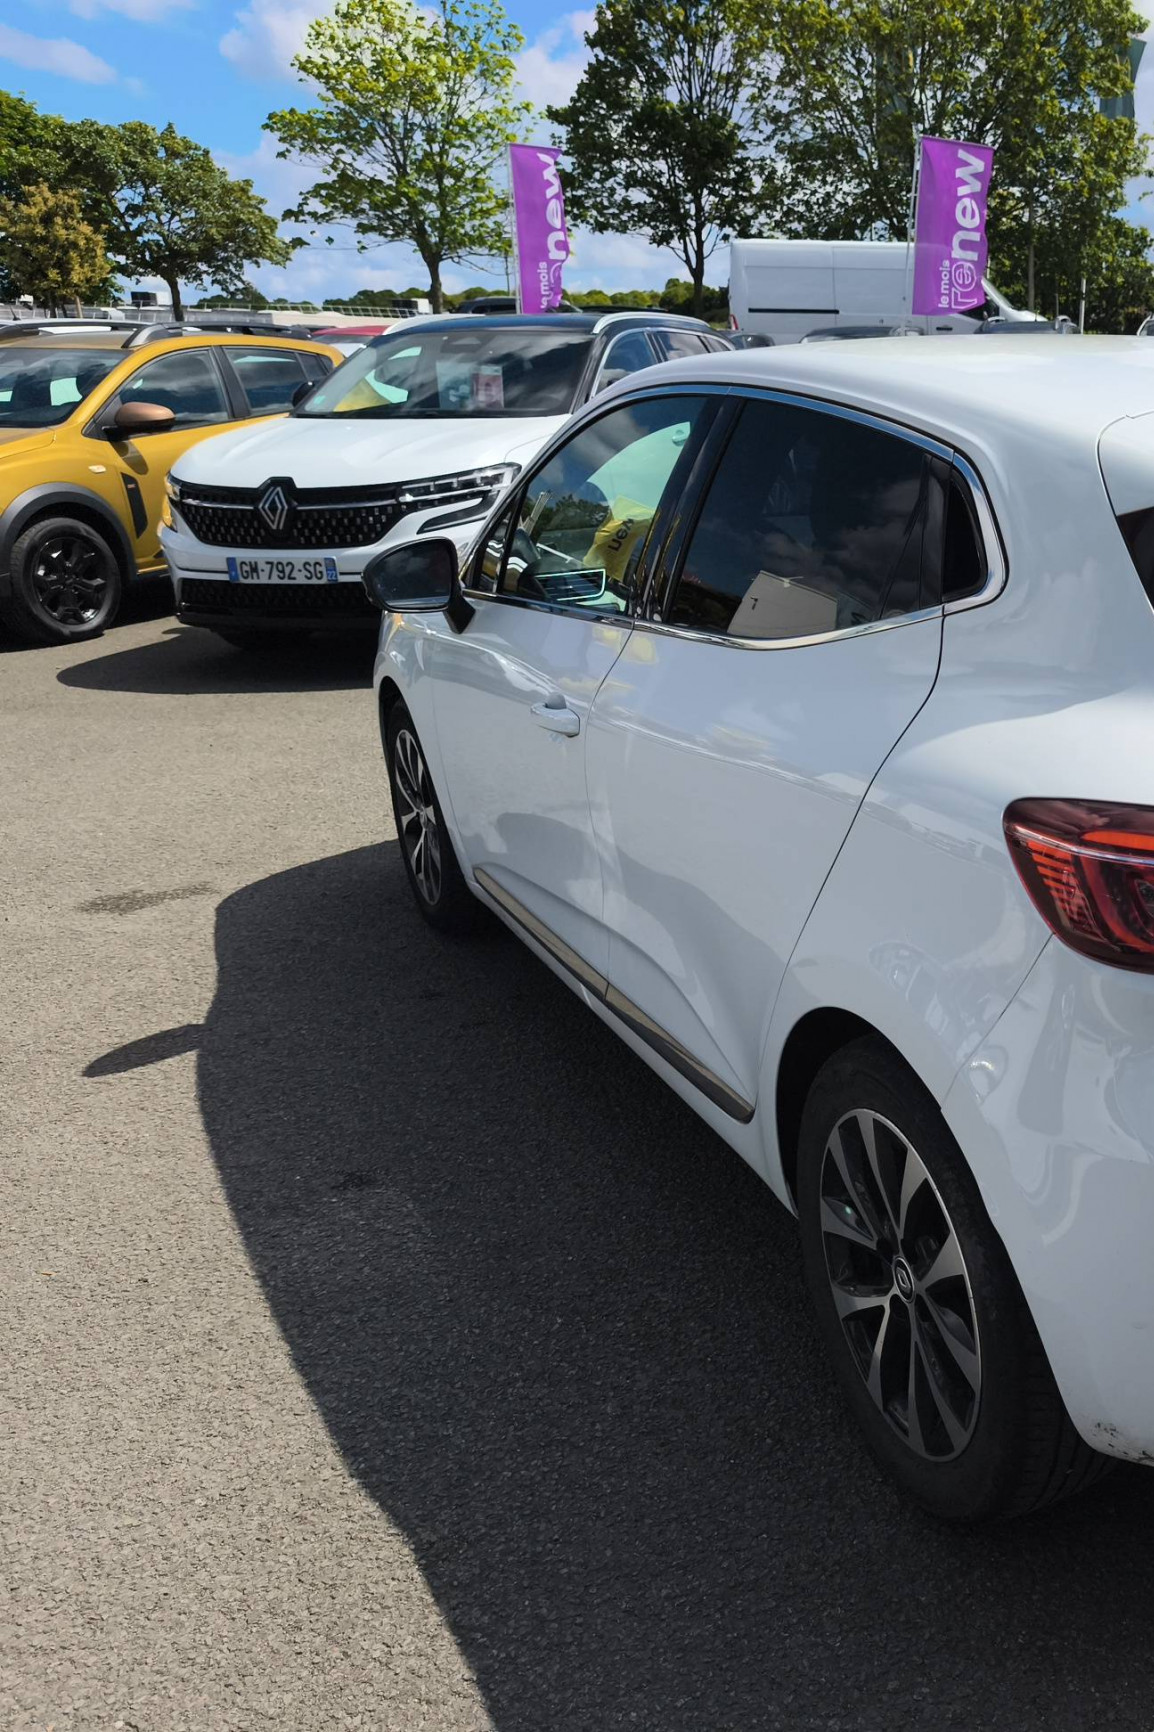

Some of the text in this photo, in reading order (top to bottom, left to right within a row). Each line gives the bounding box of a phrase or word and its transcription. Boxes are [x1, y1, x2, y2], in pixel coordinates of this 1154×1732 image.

[951, 149, 985, 309] renew
[537, 261, 549, 294] mois
[938, 259, 951, 308] le mois
[326, 571, 337, 580] 22
